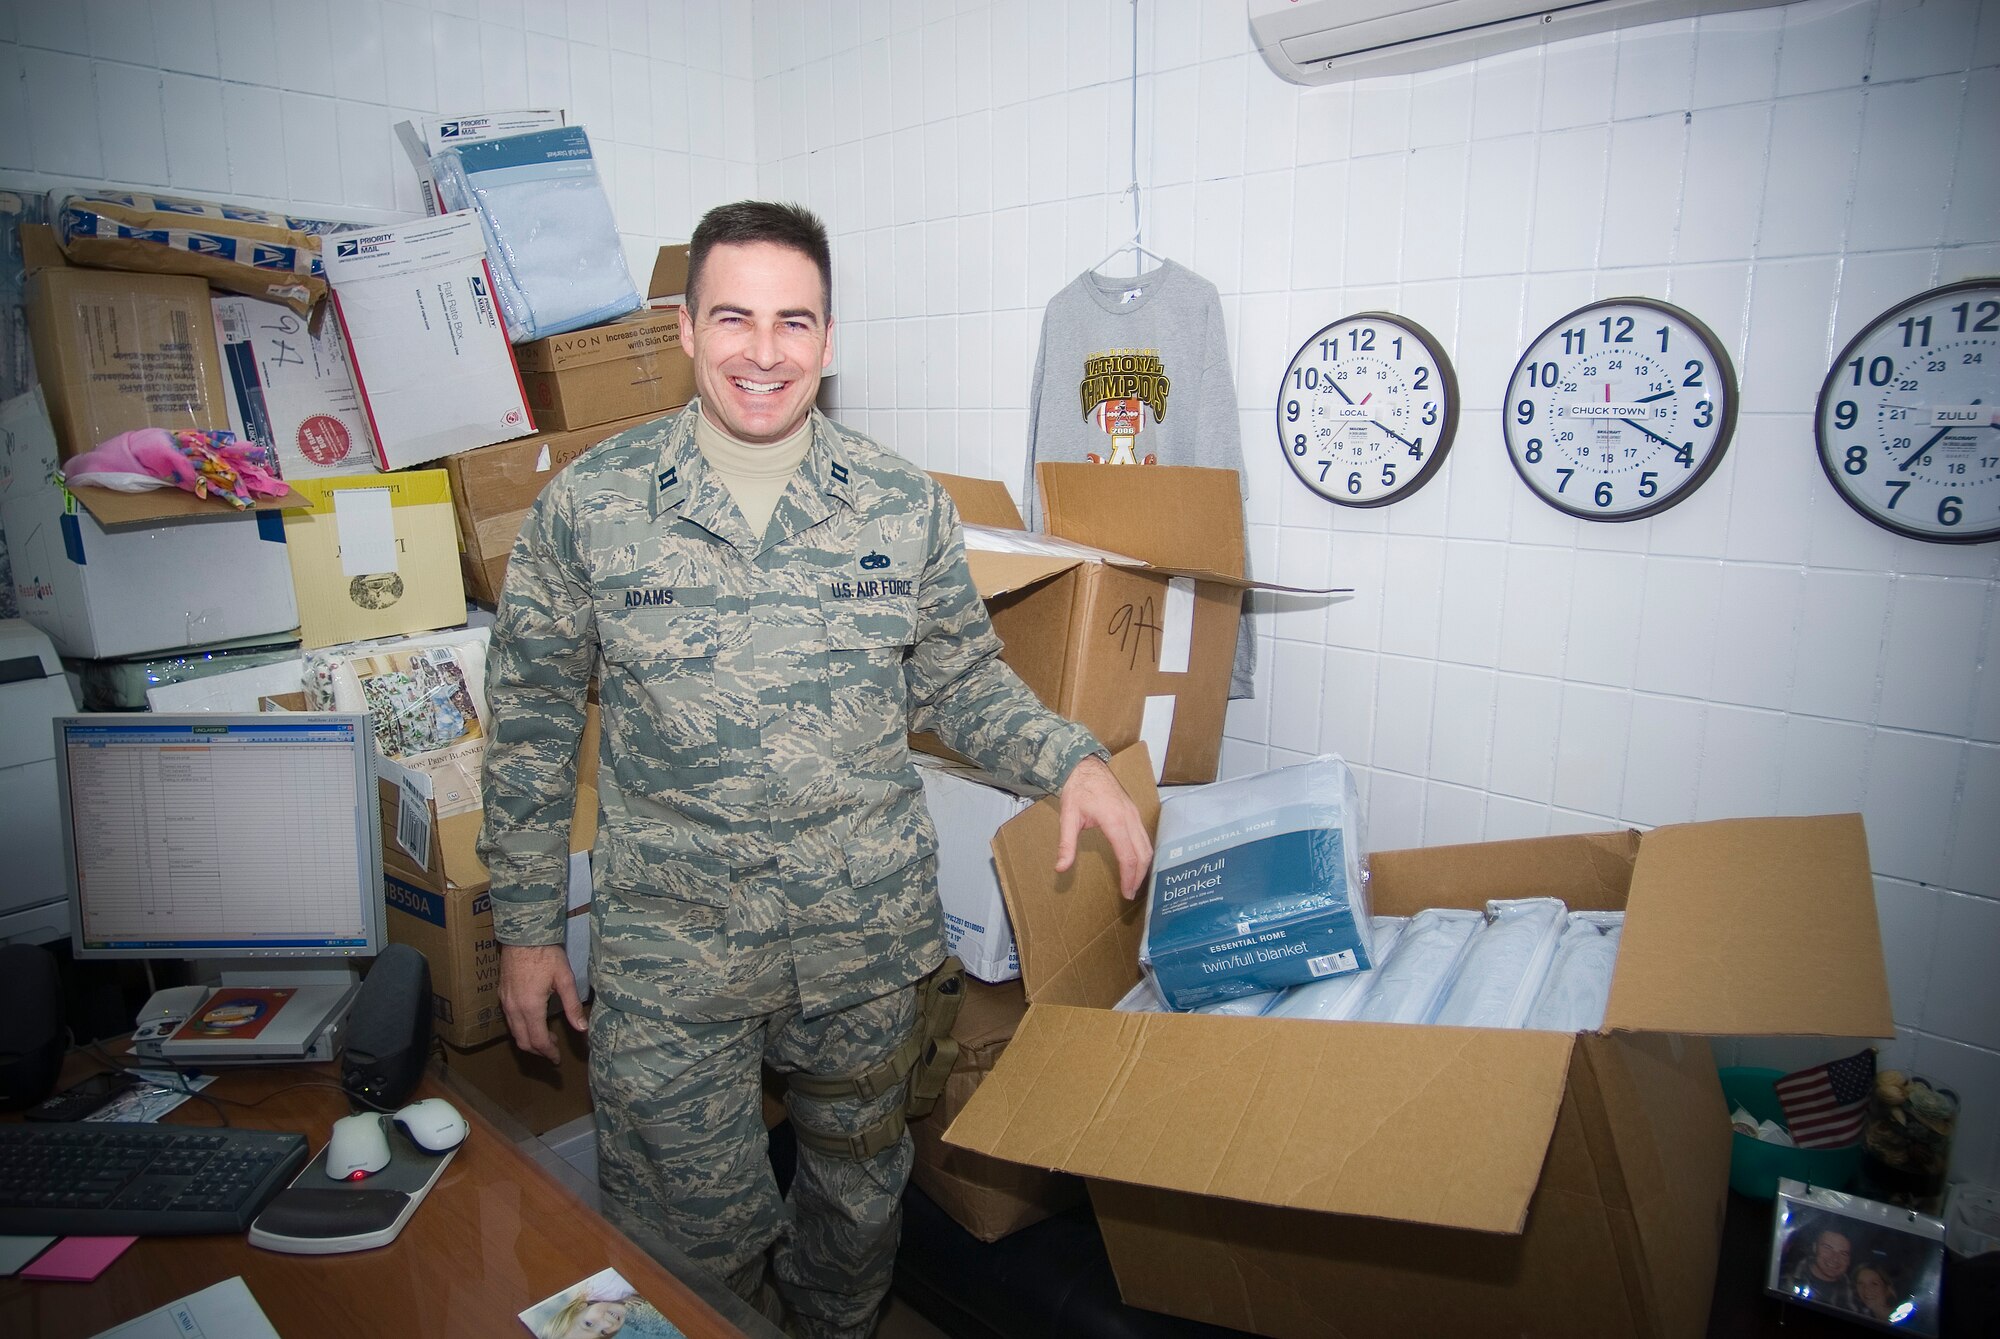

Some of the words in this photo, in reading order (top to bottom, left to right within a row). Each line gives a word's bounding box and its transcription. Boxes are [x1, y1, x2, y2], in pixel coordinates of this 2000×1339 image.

[461, 119, 488, 127] PRIORITY
[360, 233, 392, 244] PRIORITY
[360, 246, 379, 254] MAIL
[442, 282, 453, 298] Flat
[448, 300, 459, 320] Rate
[454, 322, 464, 340] Box
[477, 298, 486, 314] MAIL
[484, 298, 496, 327] PRIORITY
[1952, 300, 2000, 332] 12
[554, 336, 600, 352] AVON
[605, 330, 638, 343] Increase
[639, 322, 679, 336] Customers
[1599, 316, 1636, 343] 12
[1898, 316, 1932, 348] 11
[260, 315, 304, 368] 9A
[627, 340, 644, 350] with
[645, 336, 662, 347] Skin
[662, 333, 680, 344] Care
[1348, 328, 1376, 351] 12
[1392, 336, 1402, 360] 1
[1561, 328, 1586, 354] 11
[1656, 326, 1670, 352] 1
[1320, 338, 1338, 360] 11
[1084, 355, 1164, 376] NATIONAL
[1608, 360, 1622, 370] 24
[1926, 361, 1946, 372] 23
[1962, 354, 1982, 365] 24
[1294, 367, 1319, 390] 10
[1336, 372, 1348, 380] 23
[1356, 366, 1368, 375] 24
[1376, 372, 1387, 380] 13
[1413, 366, 1430, 390] 2
[1526, 362, 1560, 388] 10
[1583, 366, 1597, 376] 23
[1634, 366, 1648, 376] 13
[1682, 360, 1704, 387] 2
[1848, 356, 1894, 387] 10
[1322, 386, 1334, 394] 22
[1388, 386, 1398, 394] 14
[1564, 382, 1578, 392] 22
[1648, 382, 1662, 392] 14
[1900, 380, 1918, 391] 22
[1286, 400, 1300, 422] 9
[1392, 408, 1402, 417] 15
[1422, 401, 1438, 425] 3
[1517, 400, 1536, 425] 9
[1572, 406, 1610, 415] CHUCK
[1612, 406, 1646, 416] TOWN
[1654, 408, 1668, 418] 15
[1693, 400, 1714, 428] 3
[1834, 400, 1858, 430] 9
[1889, 409, 1907, 420] 21
[1936, 412, 1978, 421] ZULU
[303, 427, 315, 444] RATE
[315, 435, 325, 448] BOX
[1320, 428, 1332, 437] 20
[1560, 432, 1574, 442] 20
[1294, 434, 1308, 456] 8
[1333, 442, 1344, 450] 19
[1352, 448, 1362, 456] 18
[1369, 443, 1380, 452] 17
[1408, 438, 1424, 460] 4
[1525, 438, 1543, 464] 8
[1577, 447, 1590, 456] 19
[1893, 438, 1911, 448] 20
[312, 445, 324, 460] FLAT
[1600, 454, 1614, 463] 18
[1624, 448, 1638, 458] 17
[1674, 442, 1694, 468] 4
[1844, 445, 1868, 475] 8
[1318, 460, 1332, 482] 7
[1948, 463, 1966, 475] 18
[1980, 457, 1999, 468] 17
[1348, 472, 1362, 494] 6
[1381, 464, 1396, 486] 5
[1556, 468, 1574, 493] 7
[1638, 472, 1658, 498] 5
[1594, 482, 1613, 508] 6
[1885, 480, 1911, 510] 7
[1937, 496, 1964, 526] 6
[624, 589, 674, 607] ADAMS
[832, 582, 854, 598] U.S.
[856, 582, 880, 597] AIR
[881, 580, 913, 596] FORCE
[1108, 596, 1164, 670] 9A
[428, 754, 448, 767] PRINT
[1188, 830, 1242, 852] ESSENTIAL
[1246, 819, 1276, 832] HOME
[1165, 858, 1226, 886] twin/full
[1164, 874, 1222, 902] blanket
[474, 900, 490, 912] TO
[1210, 938, 1258, 954] ESSENTIAL
[1260, 930, 1286, 943] HOME
[476, 953, 500, 967] Mul
[1202, 952, 1254, 974] twin/full
[1258, 940, 1308, 962] blanket
[476, 968, 500, 982] Whi
[477, 984, 494, 994] H23
